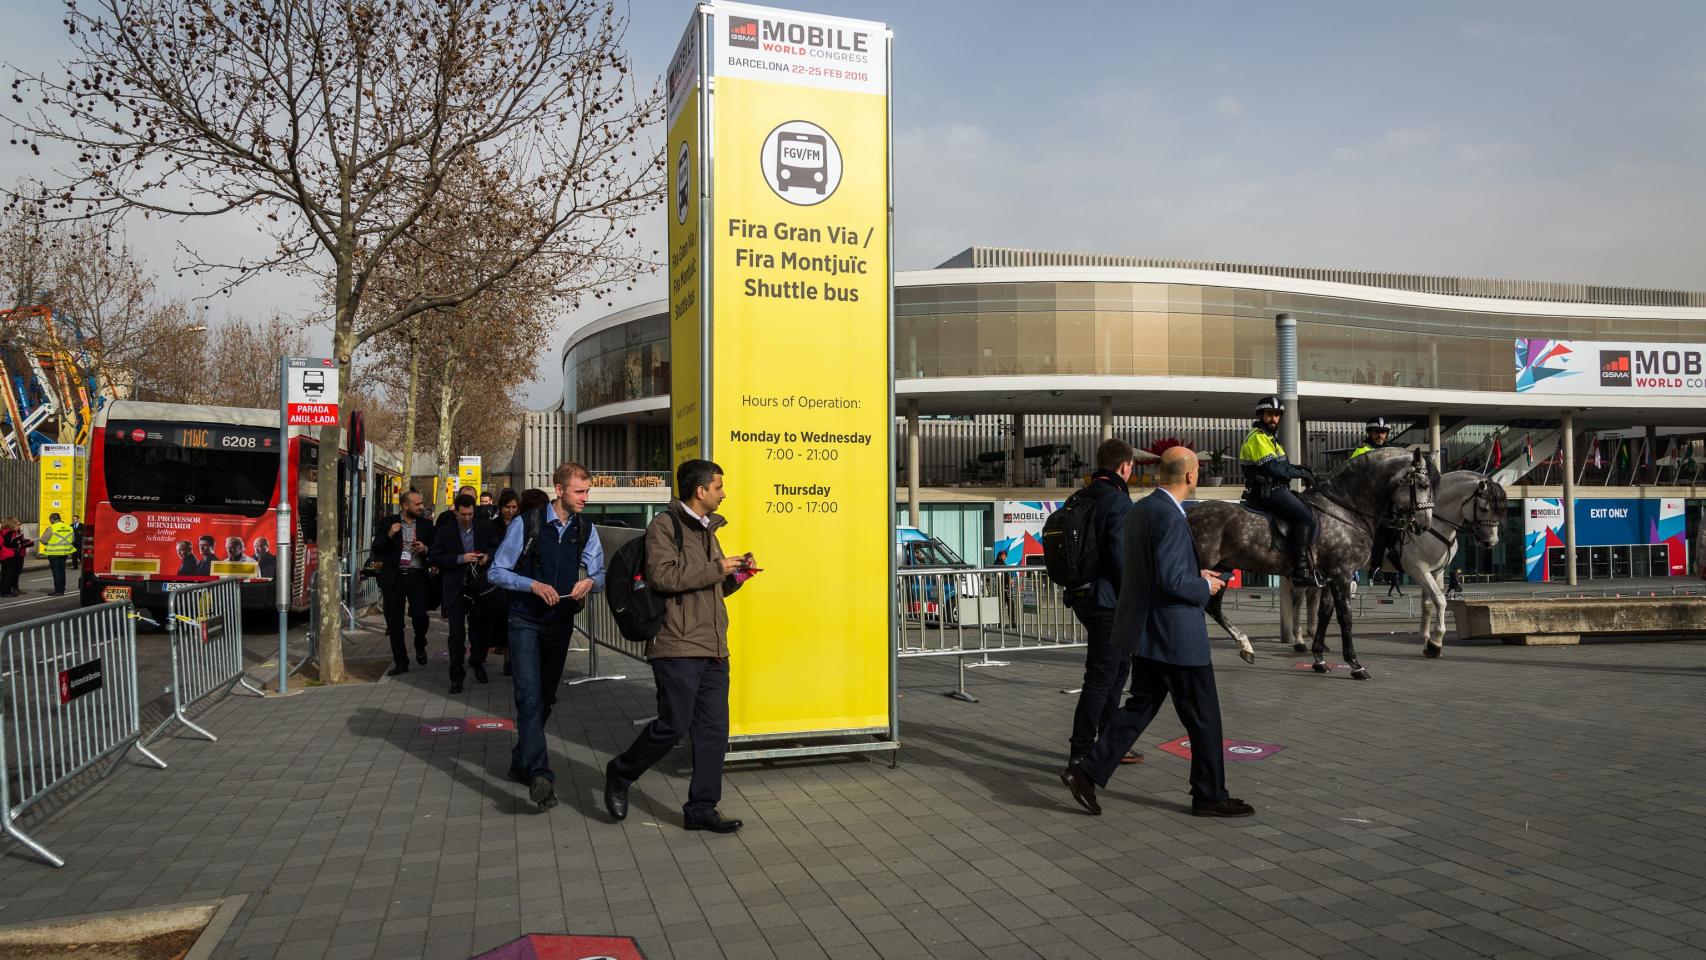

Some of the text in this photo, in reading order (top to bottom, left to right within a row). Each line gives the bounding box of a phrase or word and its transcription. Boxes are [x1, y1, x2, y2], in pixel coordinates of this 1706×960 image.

[730, 33, 757, 42] GSMA
[763, 20, 868, 52] MOBILE
[763, 43, 868, 63] WORLD CONGRESS
[728, 56, 868, 82] BARCELONA 22-25 FEB 2016
[784, 147, 820, 161] FGV/FM
[729, 218, 874, 248] Fira Gran Via /
[736, 248, 867, 276] Fira Montjuïc
[744, 278, 859, 302] Shuttle bus
[1636, 378, 1706, 388] WORLD CO
[742, 394, 861, 410] Hours of Operation:
[297, 405, 330, 414] PARADA
[182, 428, 209, 448] MWC
[222, 436, 257, 448] 6208
[730, 430, 872, 446] Monday to Wednesday
[766, 448, 794, 460] 7:00
[806, 449, 839, 461] 21:00
[774, 484, 831, 498] Thursday
[765, 501, 794, 513] 7:00
[806, 501, 838, 513] 17:00
[1537, 508, 1561, 516] MOBILE
[1590, 508, 1628, 518] EXIT ONLY
[146, 522, 191, 530] BERNHARDI
[157, 515, 201, 524] PROFESSOR
